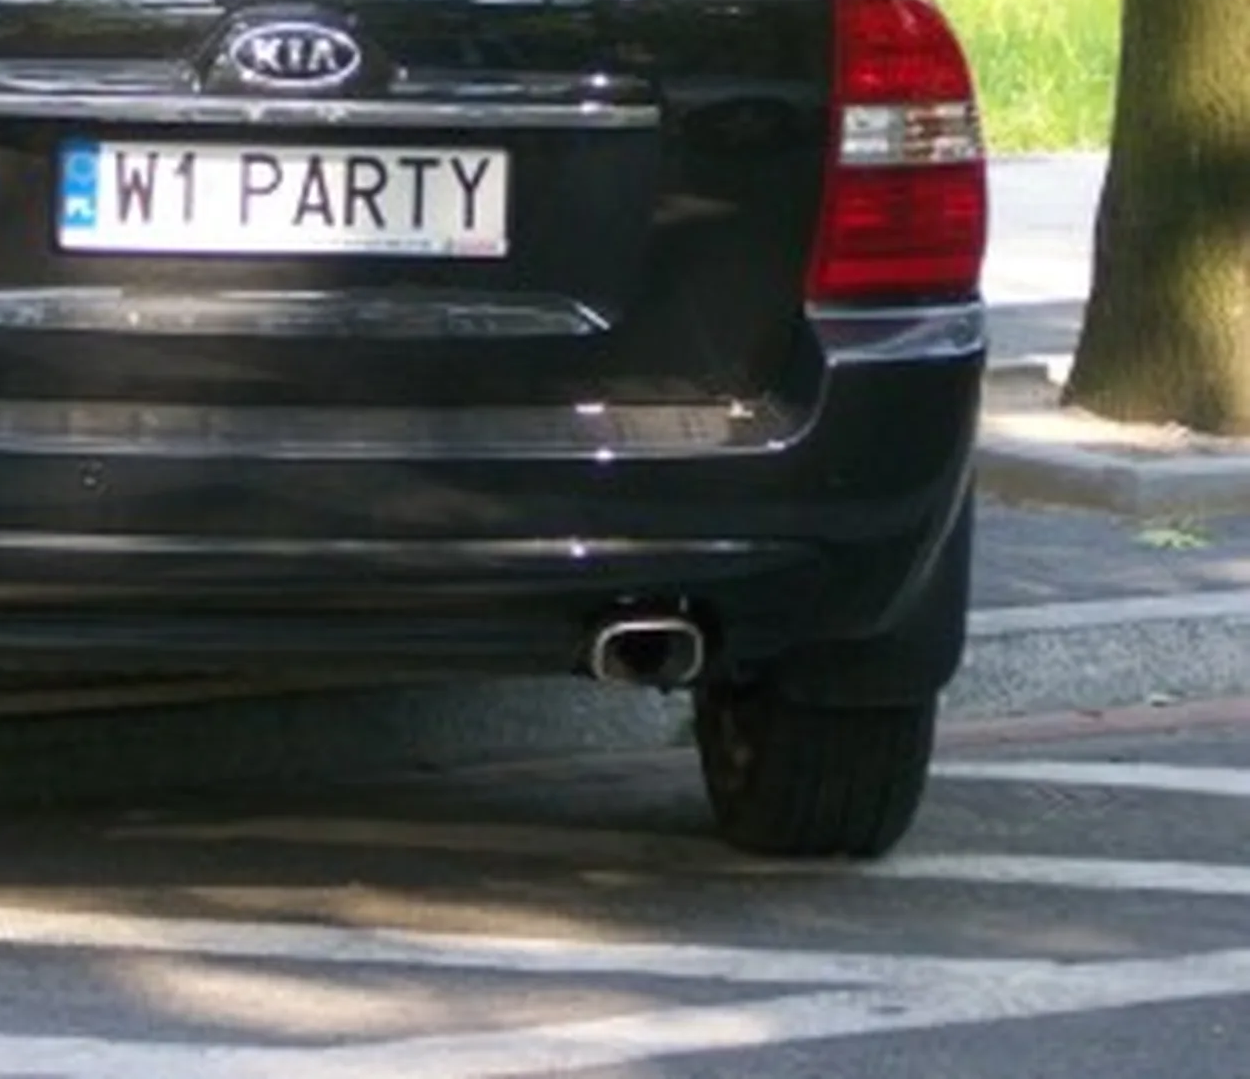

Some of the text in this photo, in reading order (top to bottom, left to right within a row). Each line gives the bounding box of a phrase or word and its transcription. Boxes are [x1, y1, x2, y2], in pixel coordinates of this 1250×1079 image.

[252, 37, 338, 72] KIA
[114, 150, 490, 230] W1 PARTY
